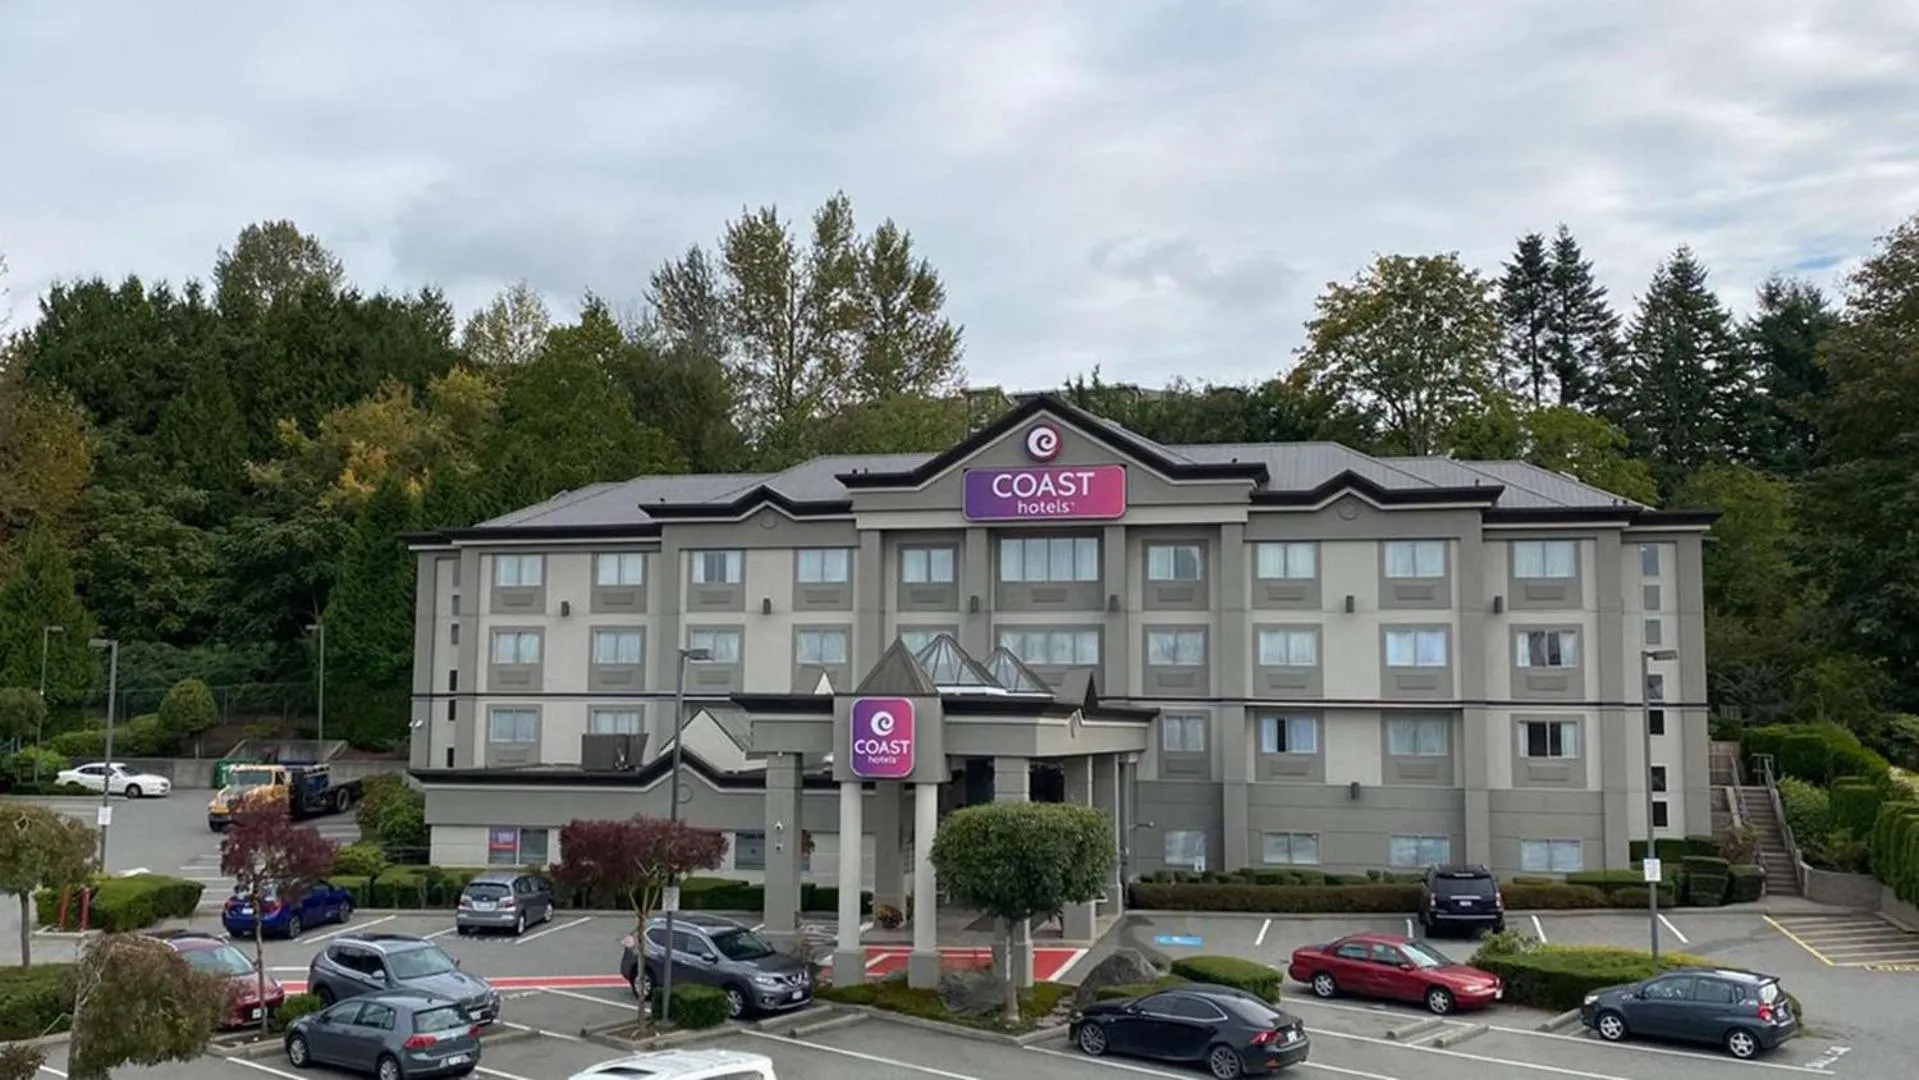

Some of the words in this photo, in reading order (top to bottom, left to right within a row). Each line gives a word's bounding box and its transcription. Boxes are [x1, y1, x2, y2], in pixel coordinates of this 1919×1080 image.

[993, 472, 1095, 498] COAST
[1017, 500, 1071, 514] hotels
[854, 739, 911, 755] COAST
